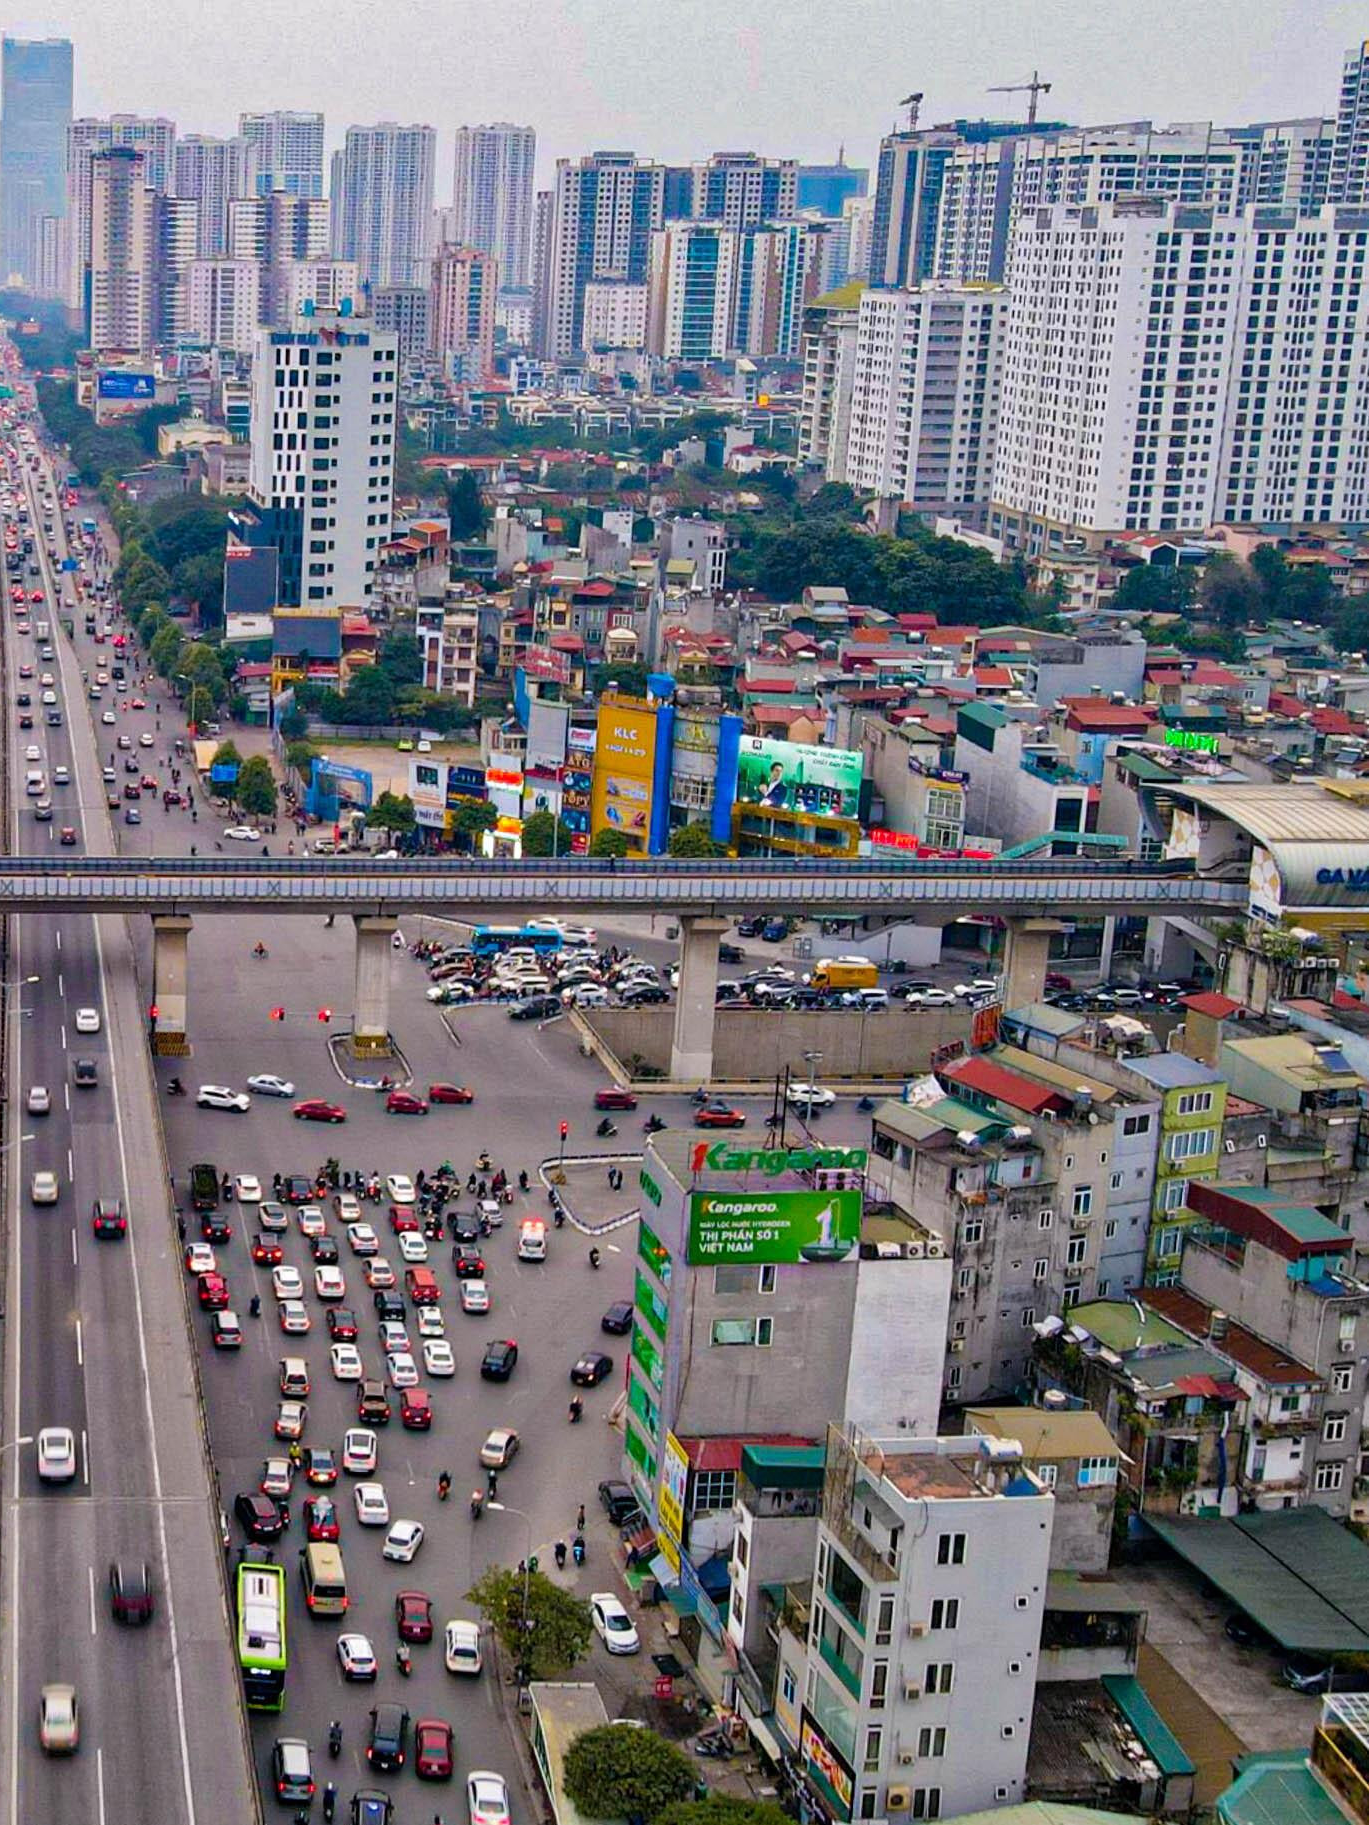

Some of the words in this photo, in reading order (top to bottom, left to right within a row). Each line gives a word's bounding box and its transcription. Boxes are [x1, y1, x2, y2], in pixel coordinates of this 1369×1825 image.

[614, 726, 638, 741] KLC
[1317, 868, 1344, 884] GA
[699, 1231, 719, 1242] THỊ
[774, 1230, 780, 1240] 1
[699, 1242, 725, 1254] VIỆT
[727, 1242, 754, 1252] NAM
